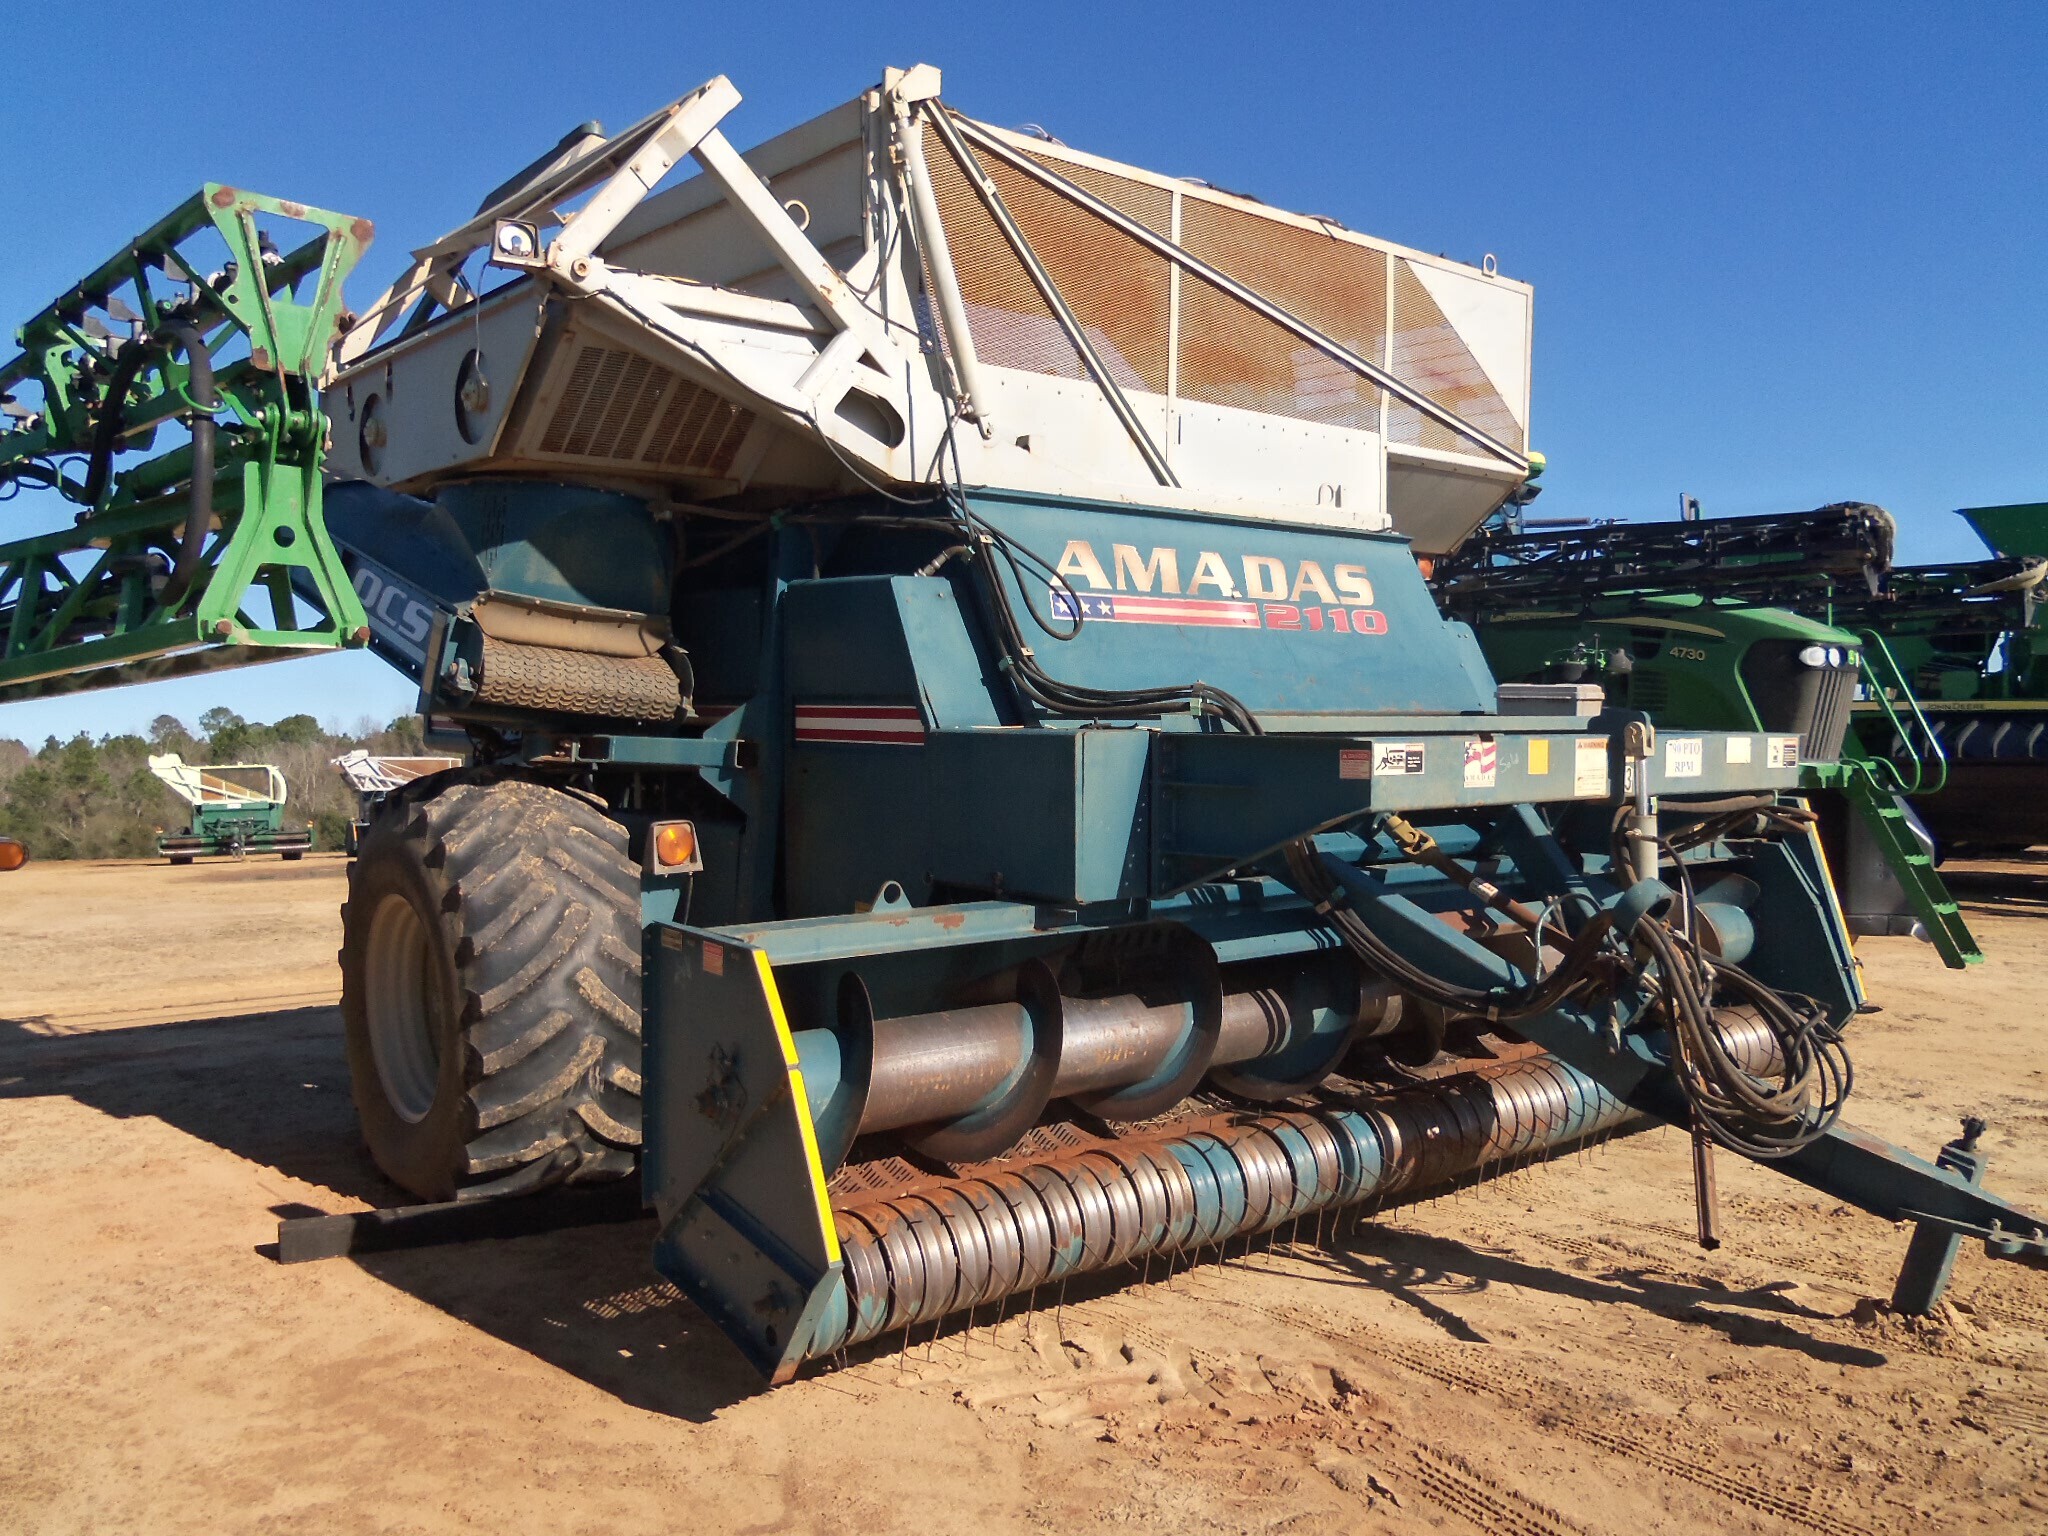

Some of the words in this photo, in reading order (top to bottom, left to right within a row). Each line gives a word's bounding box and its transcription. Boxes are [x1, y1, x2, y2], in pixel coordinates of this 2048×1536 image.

[1050, 540, 1375, 606] AMADAS
[1263, 603, 1388, 635] 2110
[1669, 646, 1706, 661] 4730
[1684, 743, 1701, 755] PTO
[1674, 761, 1694, 773] RPM
